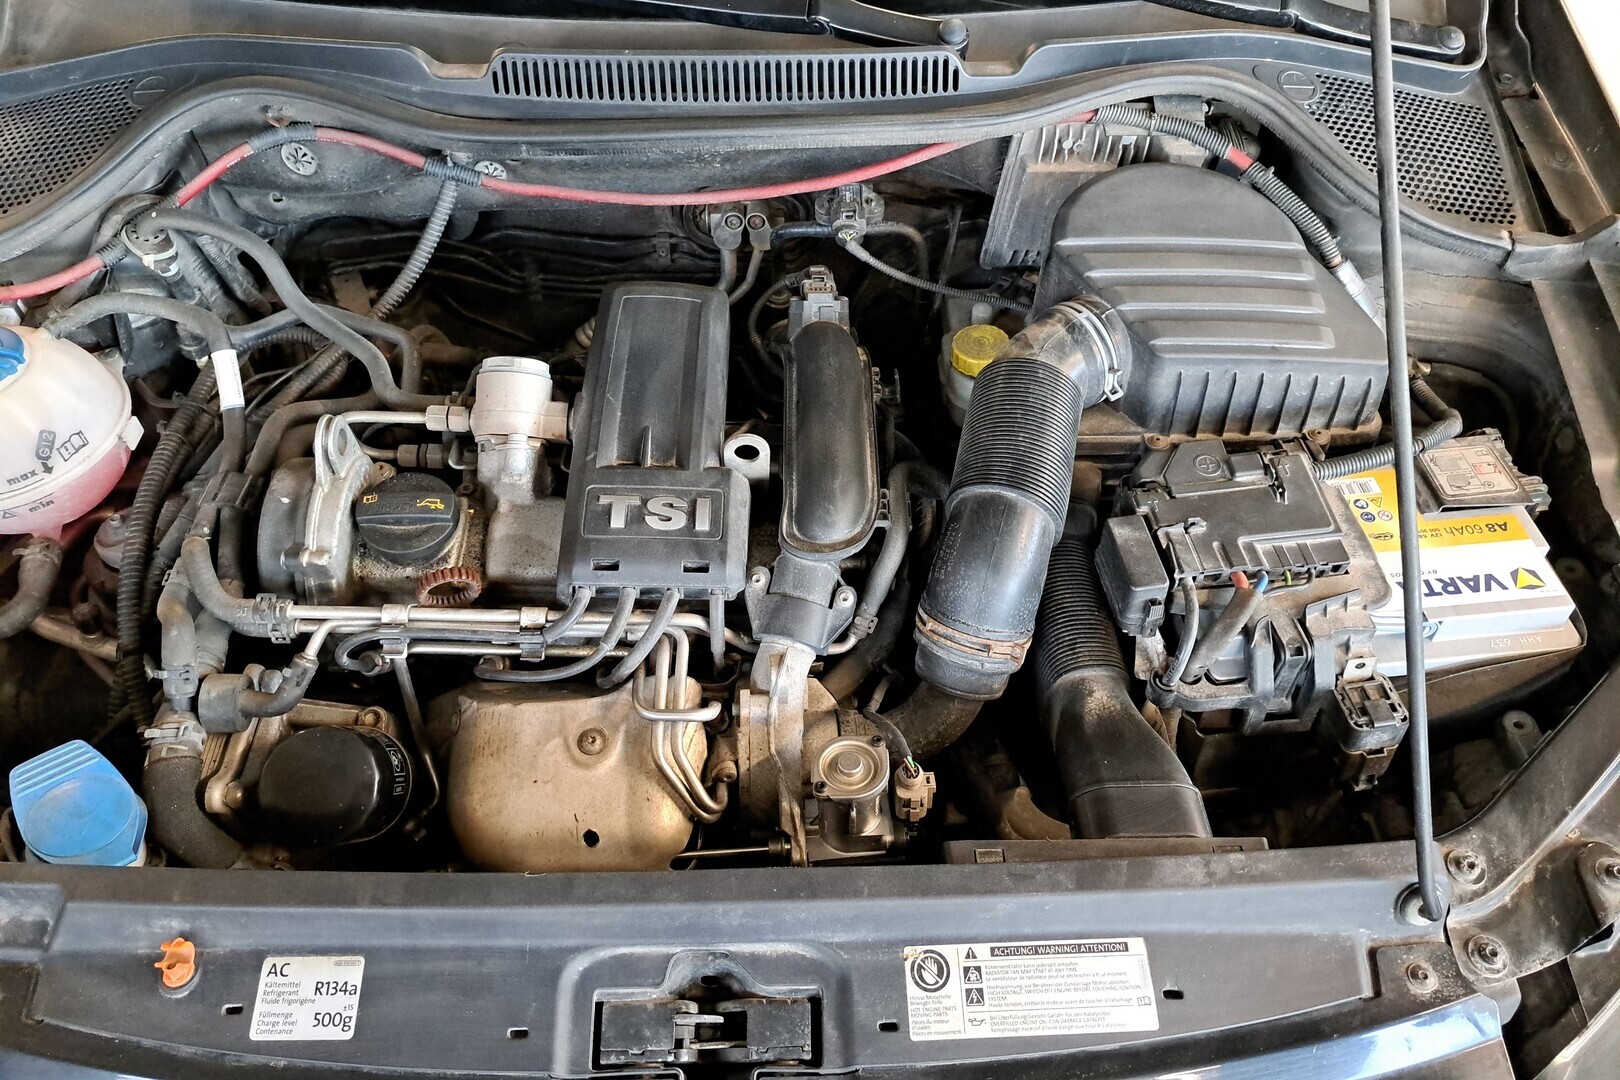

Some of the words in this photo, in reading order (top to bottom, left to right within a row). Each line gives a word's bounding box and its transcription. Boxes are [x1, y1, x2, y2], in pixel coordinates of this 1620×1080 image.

[39, 433, 54, 457] G12
[6, 469, 39, 486] max
[28, 500, 55, 513] min
[597, 494, 711, 531] TSI
[1444, 524, 1483, 536] 60Ah
[1485, 521, 1508, 533] A8
[1490, 637, 1511, 648] 637
[1519, 635, 1542, 645] AHH
[993, 947, 1035, 956] ACHTUNG!
[1037, 945, 1078, 954] WARNING!
[1080, 943, 1126, 952] ATTENTION!
[266, 962, 291, 977] AC
[262, 990, 299, 998] Refrigerant
[314, 981, 358, 996] R134a
[281, 997, 316, 1006] frigorigène
[259, 1011, 293, 1019] Füllmenge
[256, 1020, 280, 1028] Charge
[312, 1012, 353, 1032] 500g
